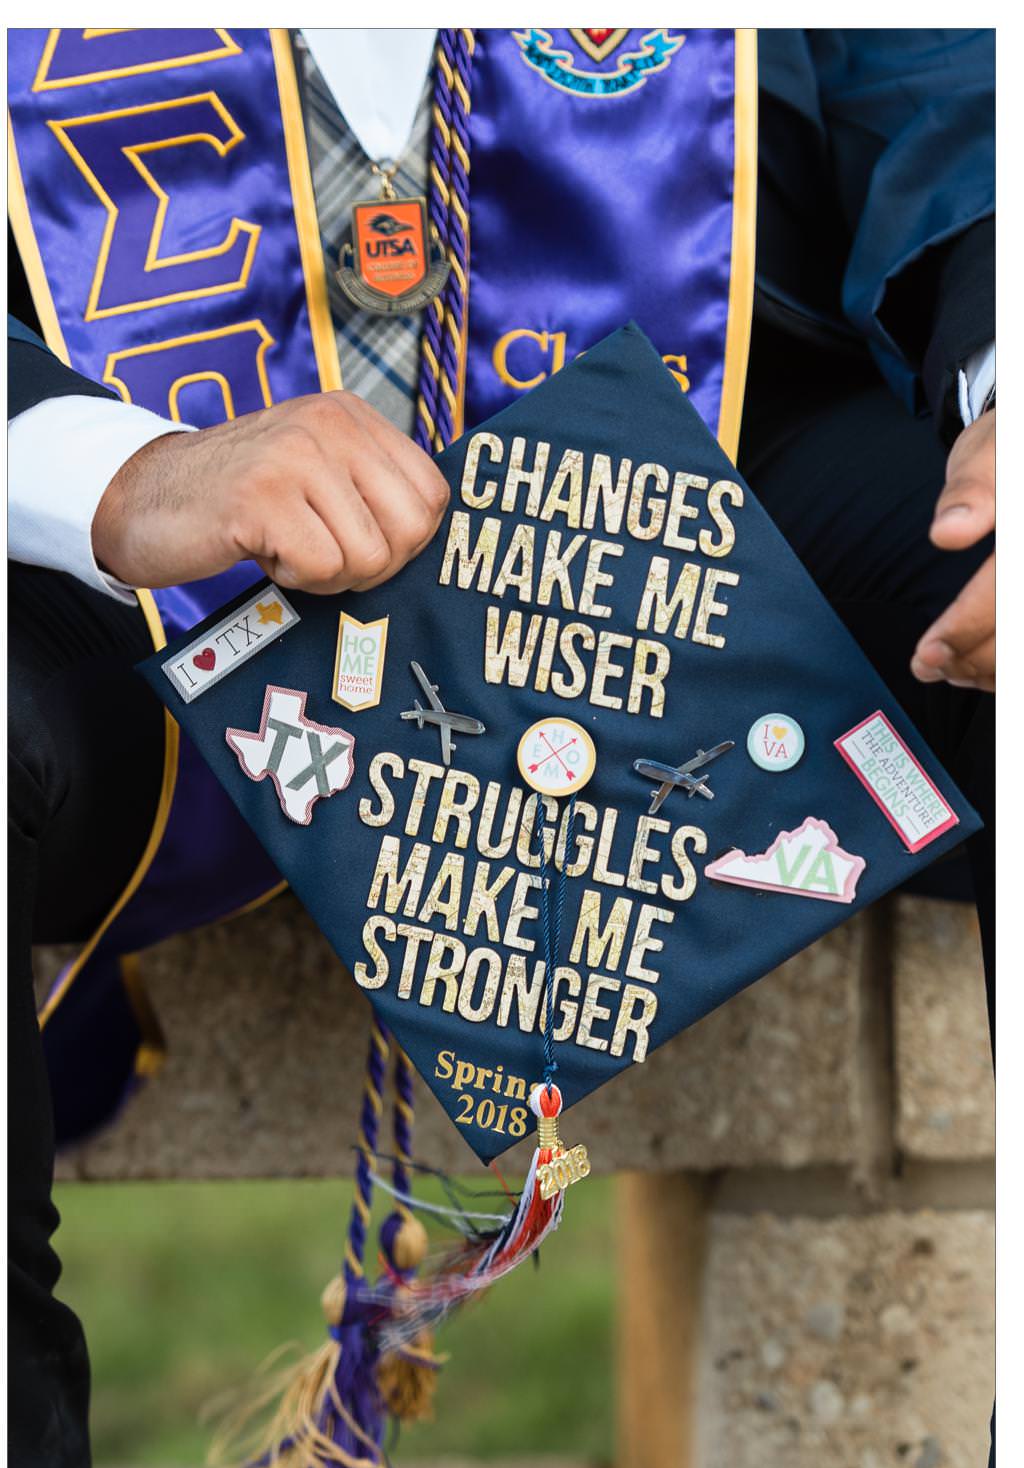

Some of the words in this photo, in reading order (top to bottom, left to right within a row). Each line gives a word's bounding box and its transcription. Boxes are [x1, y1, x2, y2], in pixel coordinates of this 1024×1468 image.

[366, 238, 416, 258] UTSA
[493, 329, 690, 393] Cls
[460, 431, 744, 558] CHANGES
[439, 511, 624, 618] MAKE
[636, 556, 740, 649] ME
[216, 615, 263, 656] TX
[484, 606, 671, 718] WISER
[339, 684, 374, 694] home
[340, 675, 373, 685] sweet
[267, 717, 349, 796] TX
[763, 741, 789, 759] VA
[861, 730, 884, 758] THE
[879, 757, 934, 829] ADVENTURE
[870, 720, 898, 753] THIS
[895, 752, 909, 769] IS
[905, 767, 948, 818] WHERE
[861, 758, 910, 817] BEGINS
[358, 752, 708, 901] STRUGGLES
[775, 844, 839, 895] VA
[366, 834, 550, 952] MAKE
[569, 889, 675, 983] ME
[354, 914, 658, 1063] STRONGER
[455, 1094, 528, 1137] 2018
[536, 1144, 591, 1200] 2018
